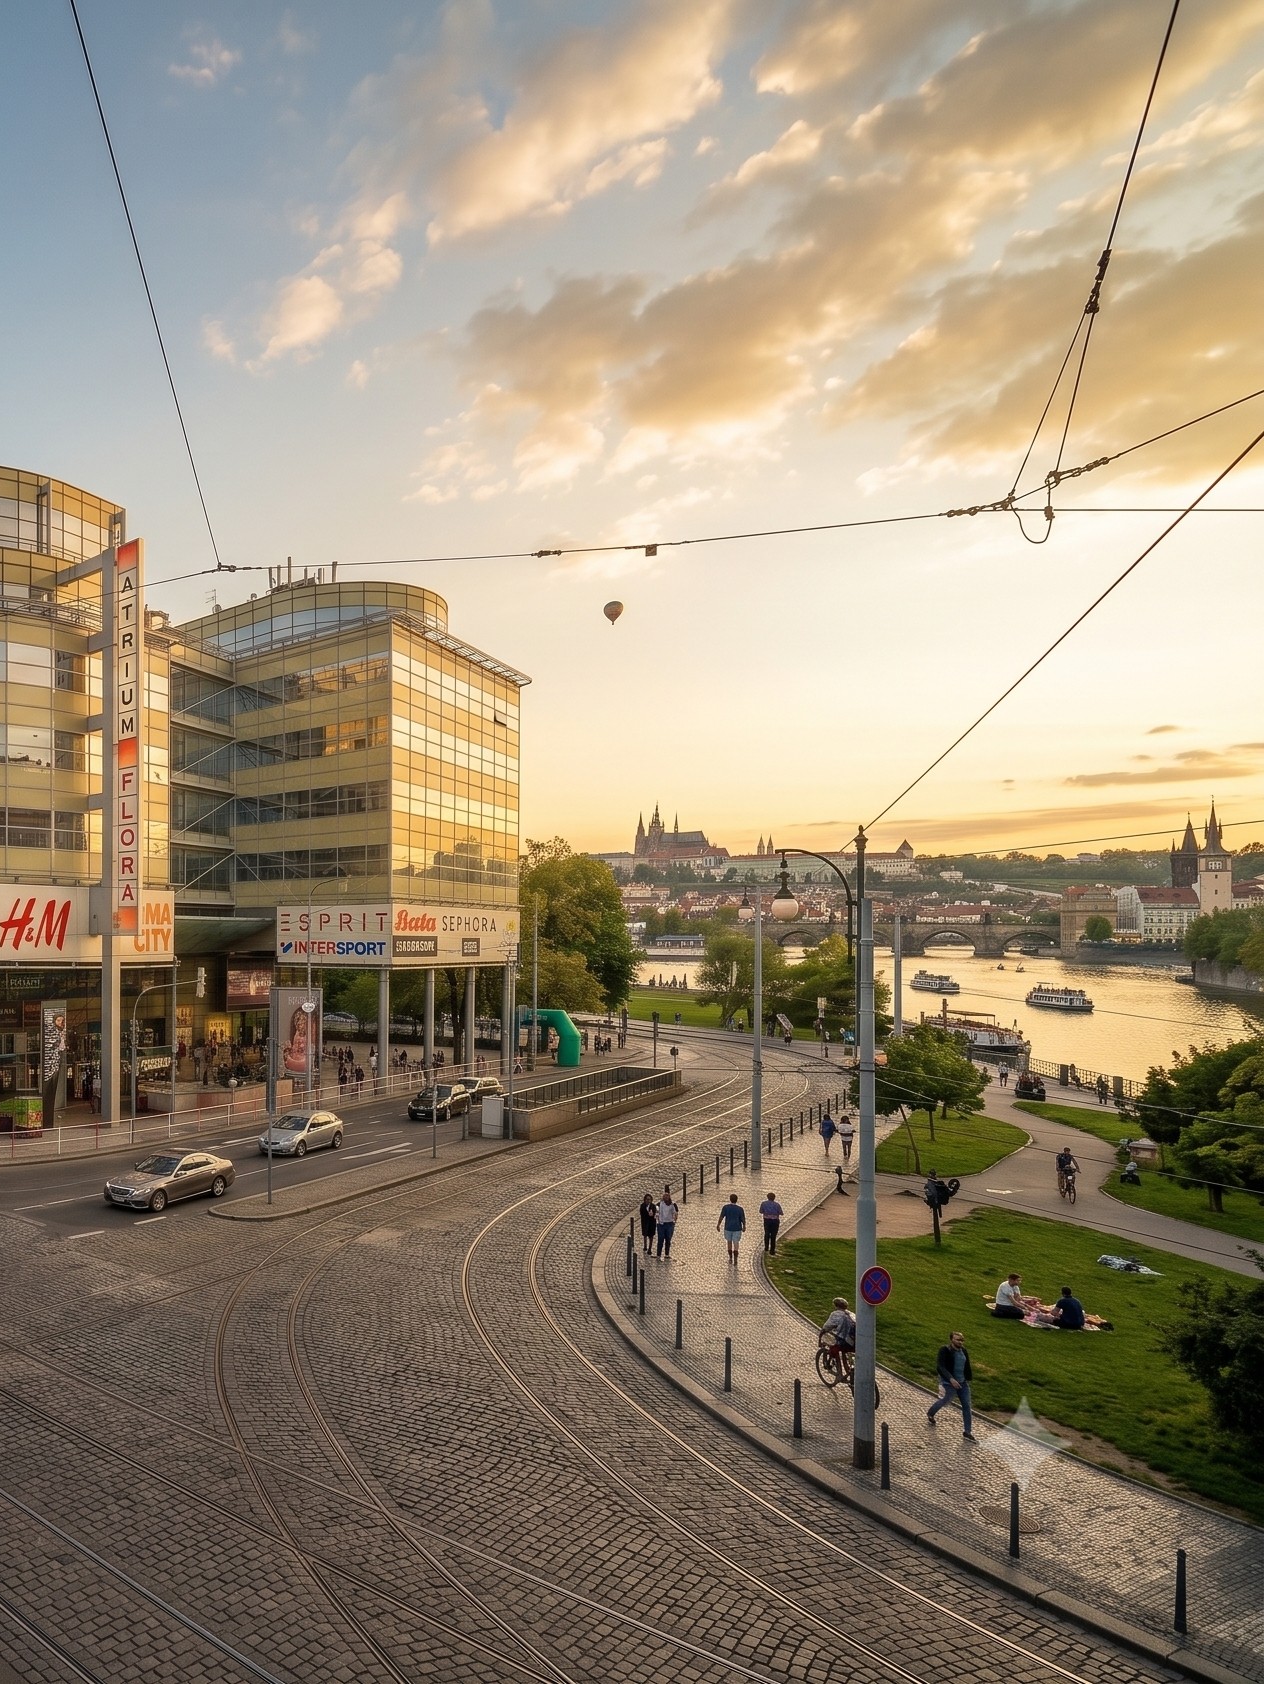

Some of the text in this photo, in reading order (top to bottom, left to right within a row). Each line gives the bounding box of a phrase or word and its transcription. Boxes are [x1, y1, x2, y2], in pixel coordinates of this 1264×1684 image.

[120, 576, 134, 901] ATRIUM FLORA
[142, 903, 172, 925] MA
[281, 913, 388, 931] ESPRIT
[395, 909, 436, 932] Bata
[442, 915, 496, 932] SEPHORA
[294, 941, 386, 955] INTERSPORT
